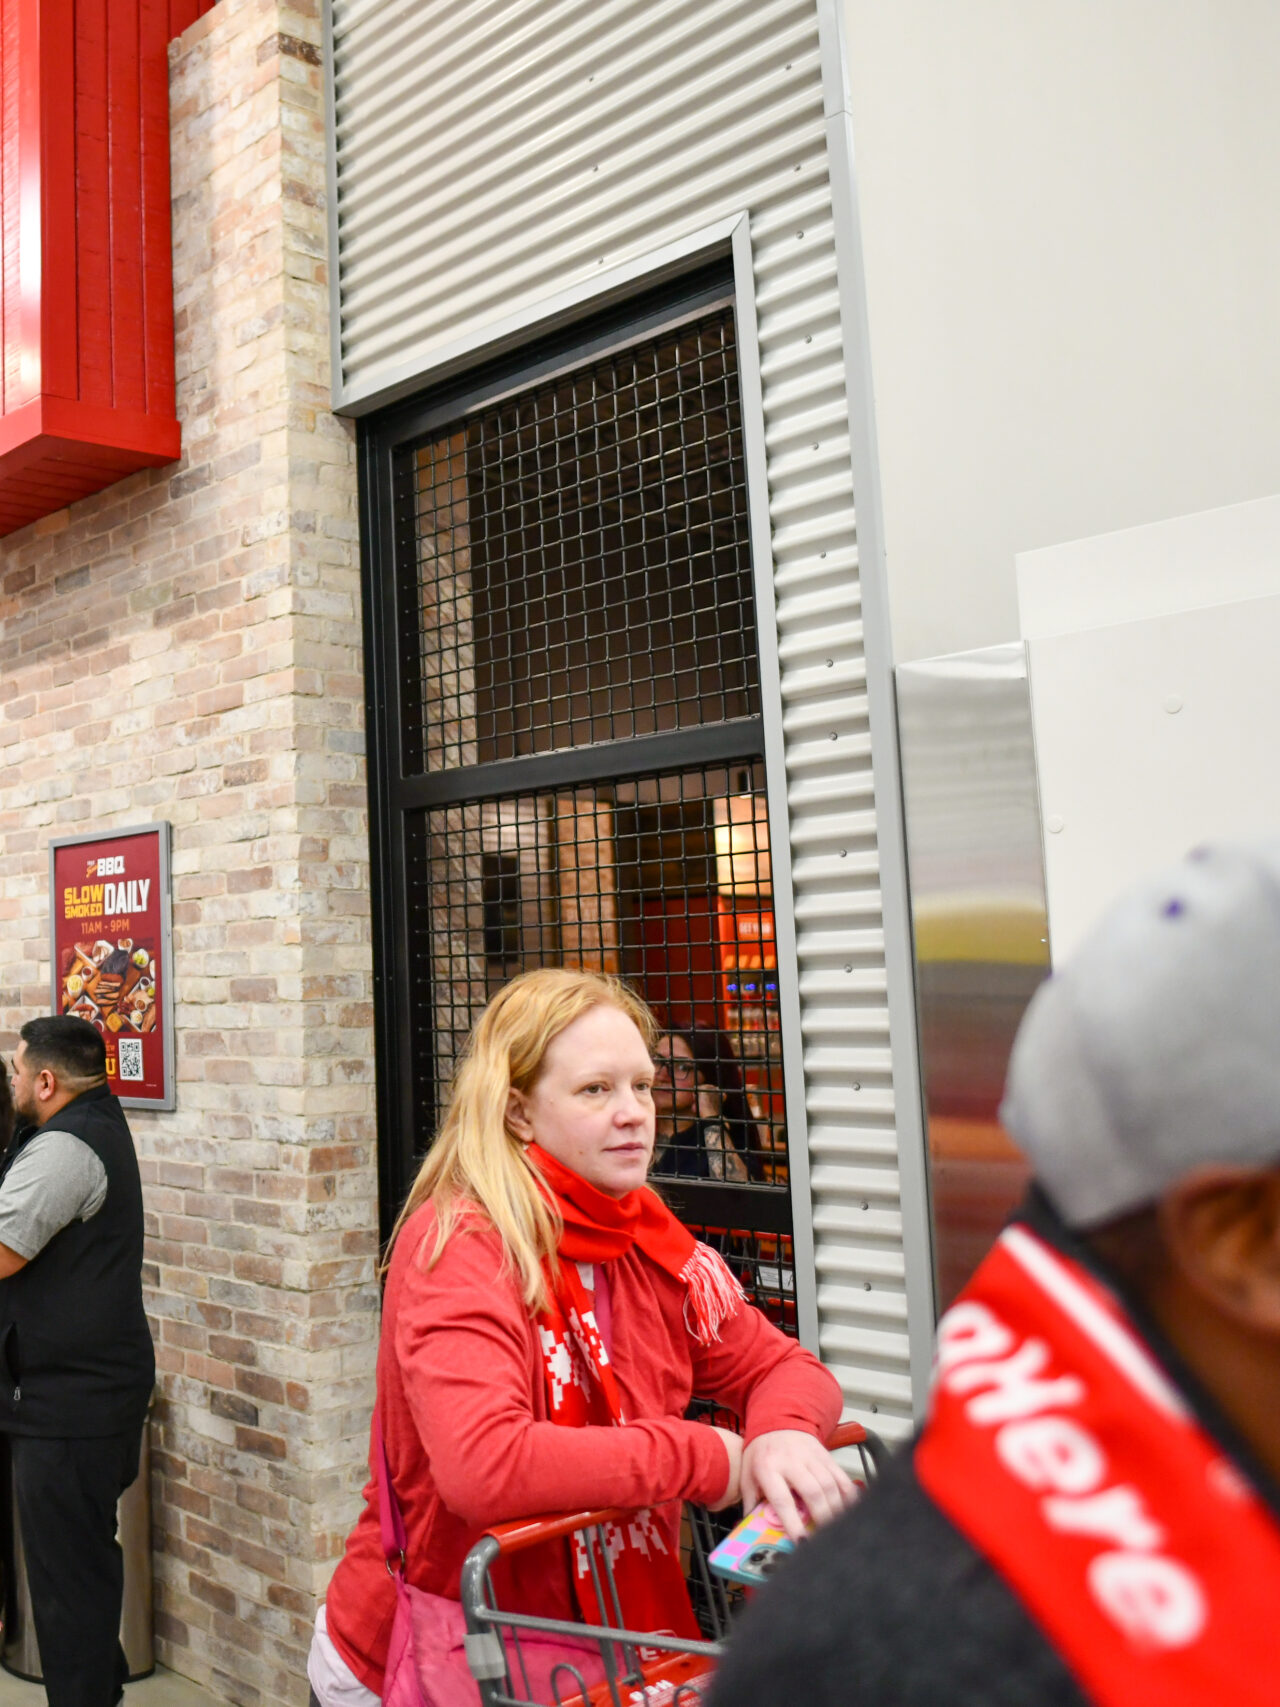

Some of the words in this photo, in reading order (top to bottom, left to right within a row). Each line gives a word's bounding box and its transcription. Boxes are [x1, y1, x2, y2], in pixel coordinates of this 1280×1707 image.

[97, 855, 125, 877] BBQ
[64, 883, 104, 905] SLOW
[104, 878, 151, 916] DAILY
[64, 902, 103, 919] SMOKED
[81, 921, 102, 934] 11AM
[110, 918, 130, 933] 9PM
